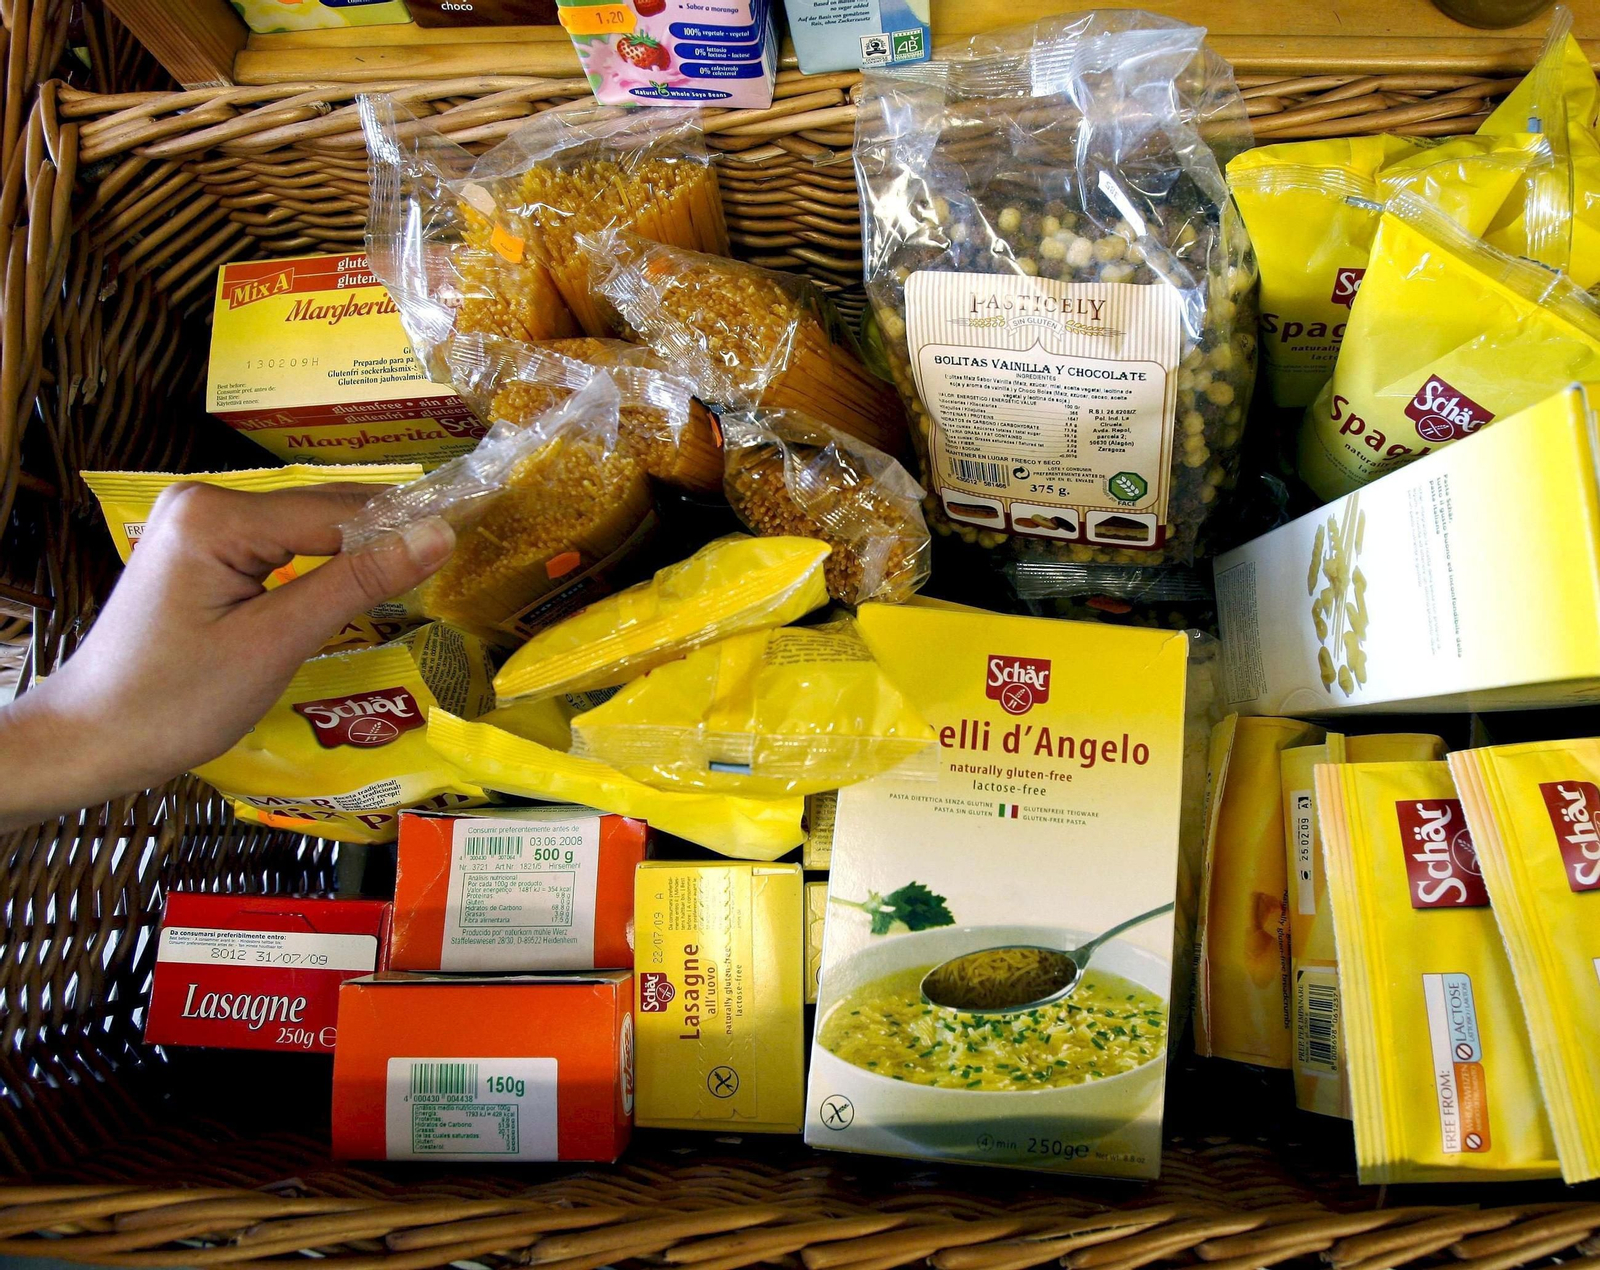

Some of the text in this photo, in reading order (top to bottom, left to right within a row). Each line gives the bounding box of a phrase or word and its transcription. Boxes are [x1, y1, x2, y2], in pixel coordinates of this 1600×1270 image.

[441, 2, 473, 11] choco
[684, 28, 701, 37] 100%
[695, 48, 706, 56] 0%
[897, 41, 918, 53] AB
[338, 257, 368, 271] glute
[338, 274, 379, 288] gluten
[232, 273, 290, 308] Mix A
[971, 292, 1106, 320] PASTICELY
[1012, 317, 1058, 330] SIN GLUTEN
[354, 358, 387, 367] Preparado
[935, 355, 1147, 381] BOLITAS VAINILLA Y CHOCOLATE
[328, 369, 358, 377] Glutenfri
[333, 402, 402, 415] glutenfree
[345, 412, 403, 424] glutenfri
[440, 417, 479, 432] Sch
[287, 427, 447, 449] Margherita
[1030, 484, 1070, 496] 375 g.
[988, 658, 1049, 691] Schär
[304, 694, 415, 728] Schär
[930, 719, 992, 751] elli
[950, 762, 1073, 782] naturally gluten-free
[358, 780, 397, 795] tradicional!
[363, 784, 401, 798] tradicional!
[377, 790, 400, 798] recept!
[973, 780, 1046, 796] lactose-free
[911, 795, 943, 803] DIETETICA
[945, 798, 965, 806] SENZA
[1023, 806, 1099, 818] GLUTENFREIE TEIGWARE
[1023, 815, 1064, 824] GLUTEN-FREE
[499, 826, 550, 834] preferentemente
[1558, 785, 1600, 885] Schär
[529, 836, 583, 846] 03.06.2008
[1301, 818, 1309, 861] 25.02.09
[534, 848, 573, 863] 500 g
[1413, 803, 1467, 904] Schär
[217, 932, 266, 940] preferibilmente
[211, 948, 247, 960] 8012
[643, 974, 659, 1011] Schär
[679, 944, 704, 1040] Lasagne
[705, 967, 716, 1014] all'uovo
[181, 984, 307, 1030] Lasagne
[1448, 982, 1468, 1042] LACTOSE
[725, 998, 733, 1035] naturally
[276, 1027, 315, 1049] 250g
[486, 1076, 525, 1098] 150g
[1439, 1070, 1457, 1149] FREE FROM:
[996, 1138, 1017, 1150] min
